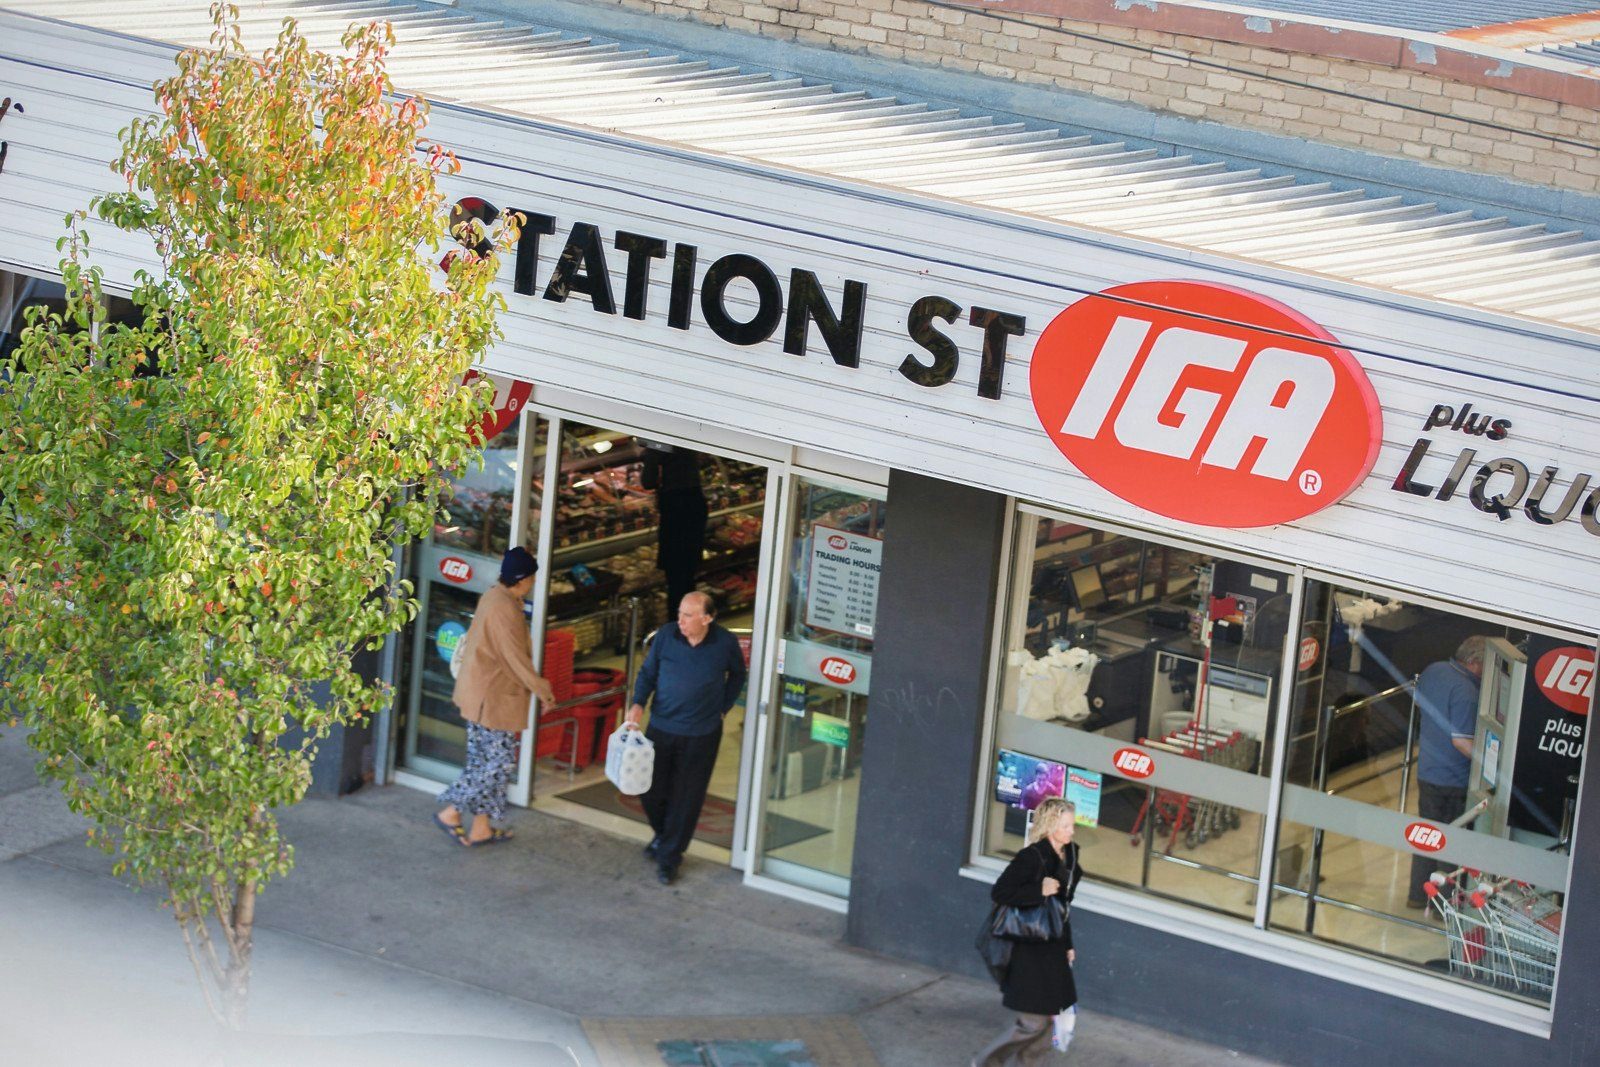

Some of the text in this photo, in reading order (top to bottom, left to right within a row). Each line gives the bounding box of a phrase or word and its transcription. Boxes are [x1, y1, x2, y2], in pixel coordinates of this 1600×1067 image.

[898, 296, 1026, 400] ST
[1059, 315, 1336, 481] IGA
[1422, 402, 1513, 441] plus
[849, 544, 873, 555] LIQUOR
[442, 560, 470, 580] IGA
[815, 550, 881, 573] TRADING HOURS
[823, 659, 853, 680] IGA
[1543, 654, 1595, 698] IG
[1544, 718, 1582, 738] plus
[1538, 734, 1585, 758] LIQU
[1116, 750, 1151, 774] IGA
[1407, 825, 1440, 847] IGA
